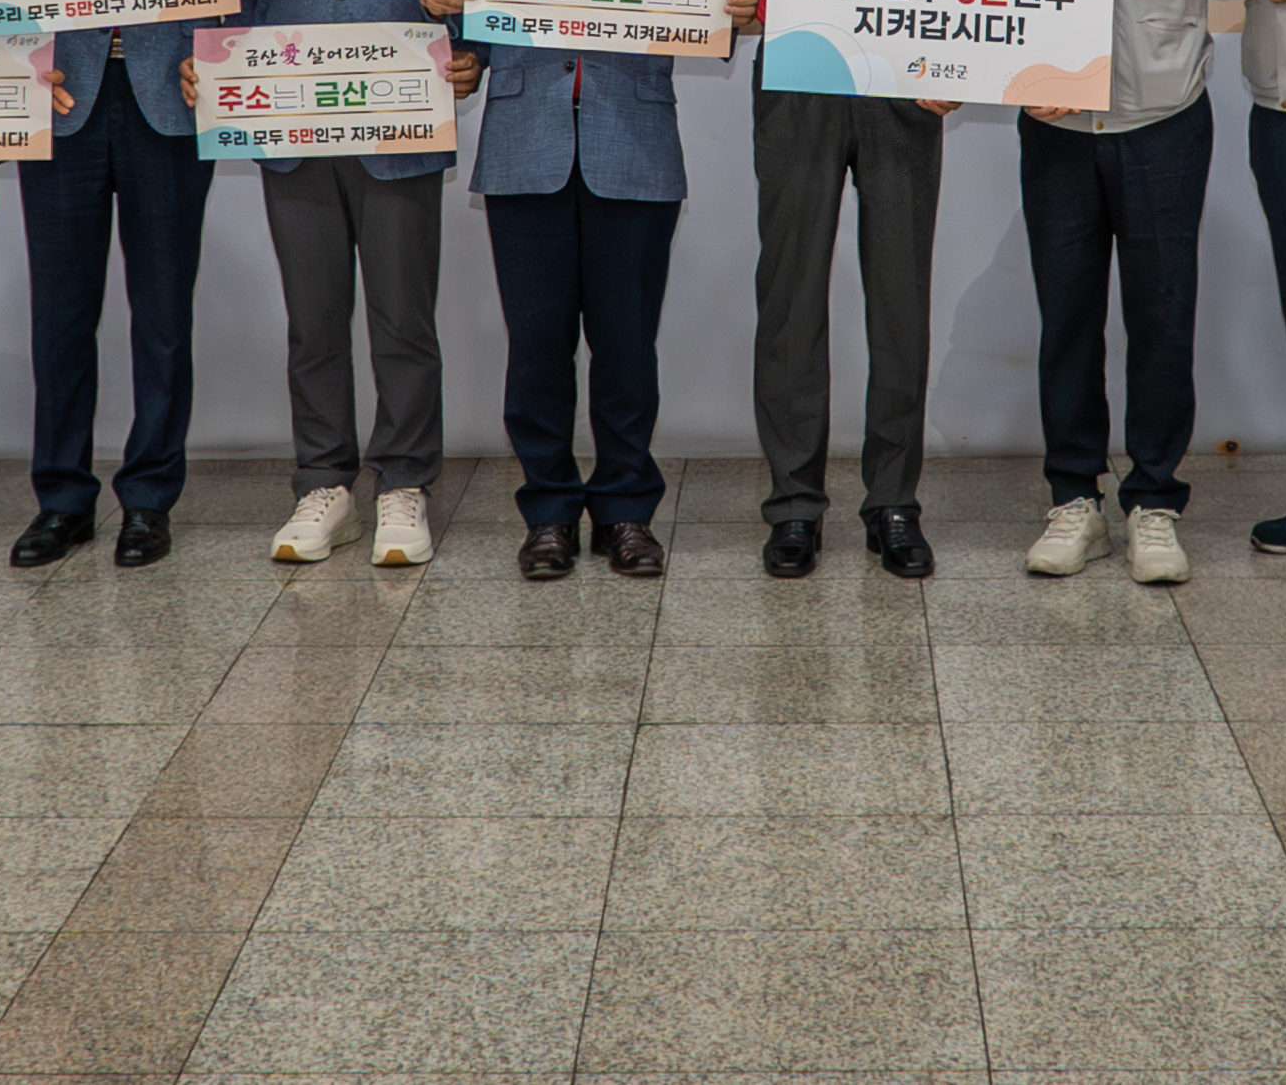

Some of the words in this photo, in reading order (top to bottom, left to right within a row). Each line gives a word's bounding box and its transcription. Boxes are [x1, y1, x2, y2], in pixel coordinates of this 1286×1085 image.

[27, 2, 60, 21] 모두
[486, 15, 516, 33] 우리
[522, 18, 554, 35] 모두
[559, 20, 617, 39] 5만인구
[623, 24, 709, 45] 지켜갑시다!
[853, 5, 1027, 46] 지켜갑시다!
[307, 44, 398, 64] 살어리랏다
[929, 62, 968, 80] 금산군
[217, 83, 304, 111] 주소는!
[314, 78, 428, 107] 금산으로!
[218, 130, 248, 147] 우리
[253, 129, 284, 145] 모두
[288, 127, 345, 144] 5만인구
[350, 124, 433, 141] 지켜갑시다!
